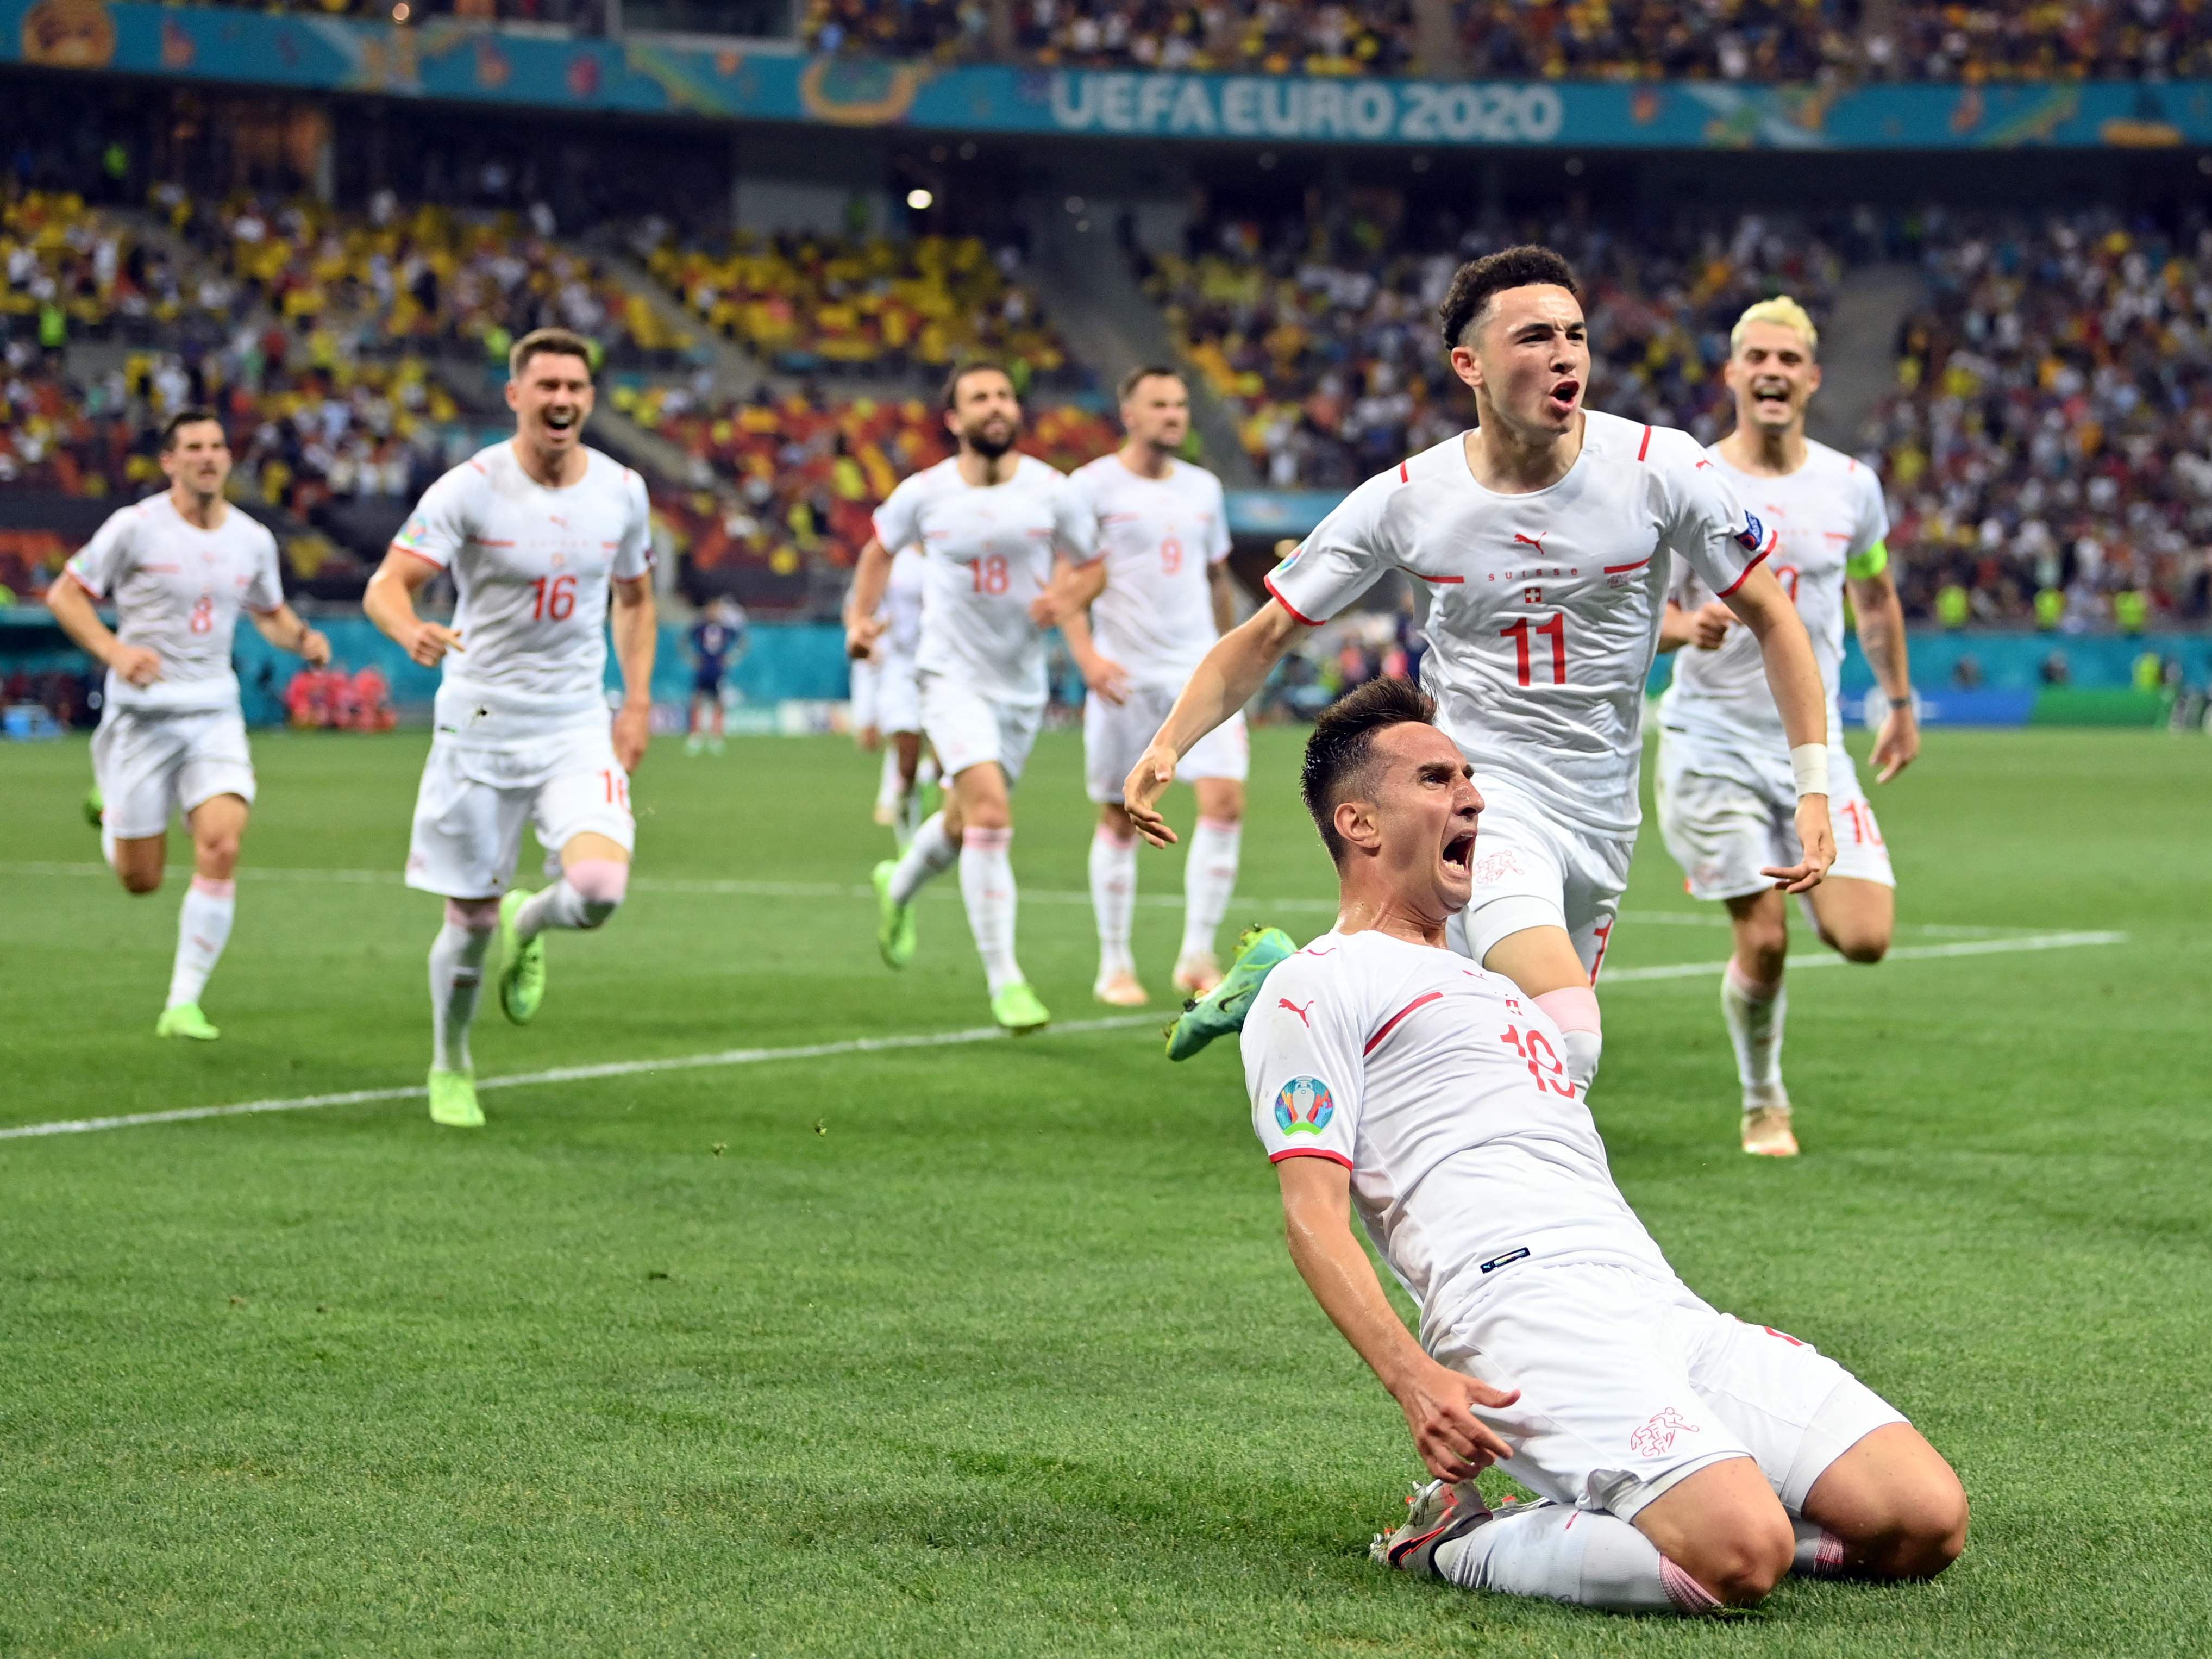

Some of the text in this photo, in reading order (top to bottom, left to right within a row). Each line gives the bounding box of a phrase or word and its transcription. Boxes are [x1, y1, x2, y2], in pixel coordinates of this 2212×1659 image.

[1052, 75, 1562, 142] UEFA EURO 2020
[968, 554, 1009, 595] 18
[1160, 538, 1183, 576] 9
[191, 597, 213, 635] 8
[526, 575, 577, 622] 16
[1500, 613, 1565, 686] 11
[1500, 1024, 1575, 1099] 19
